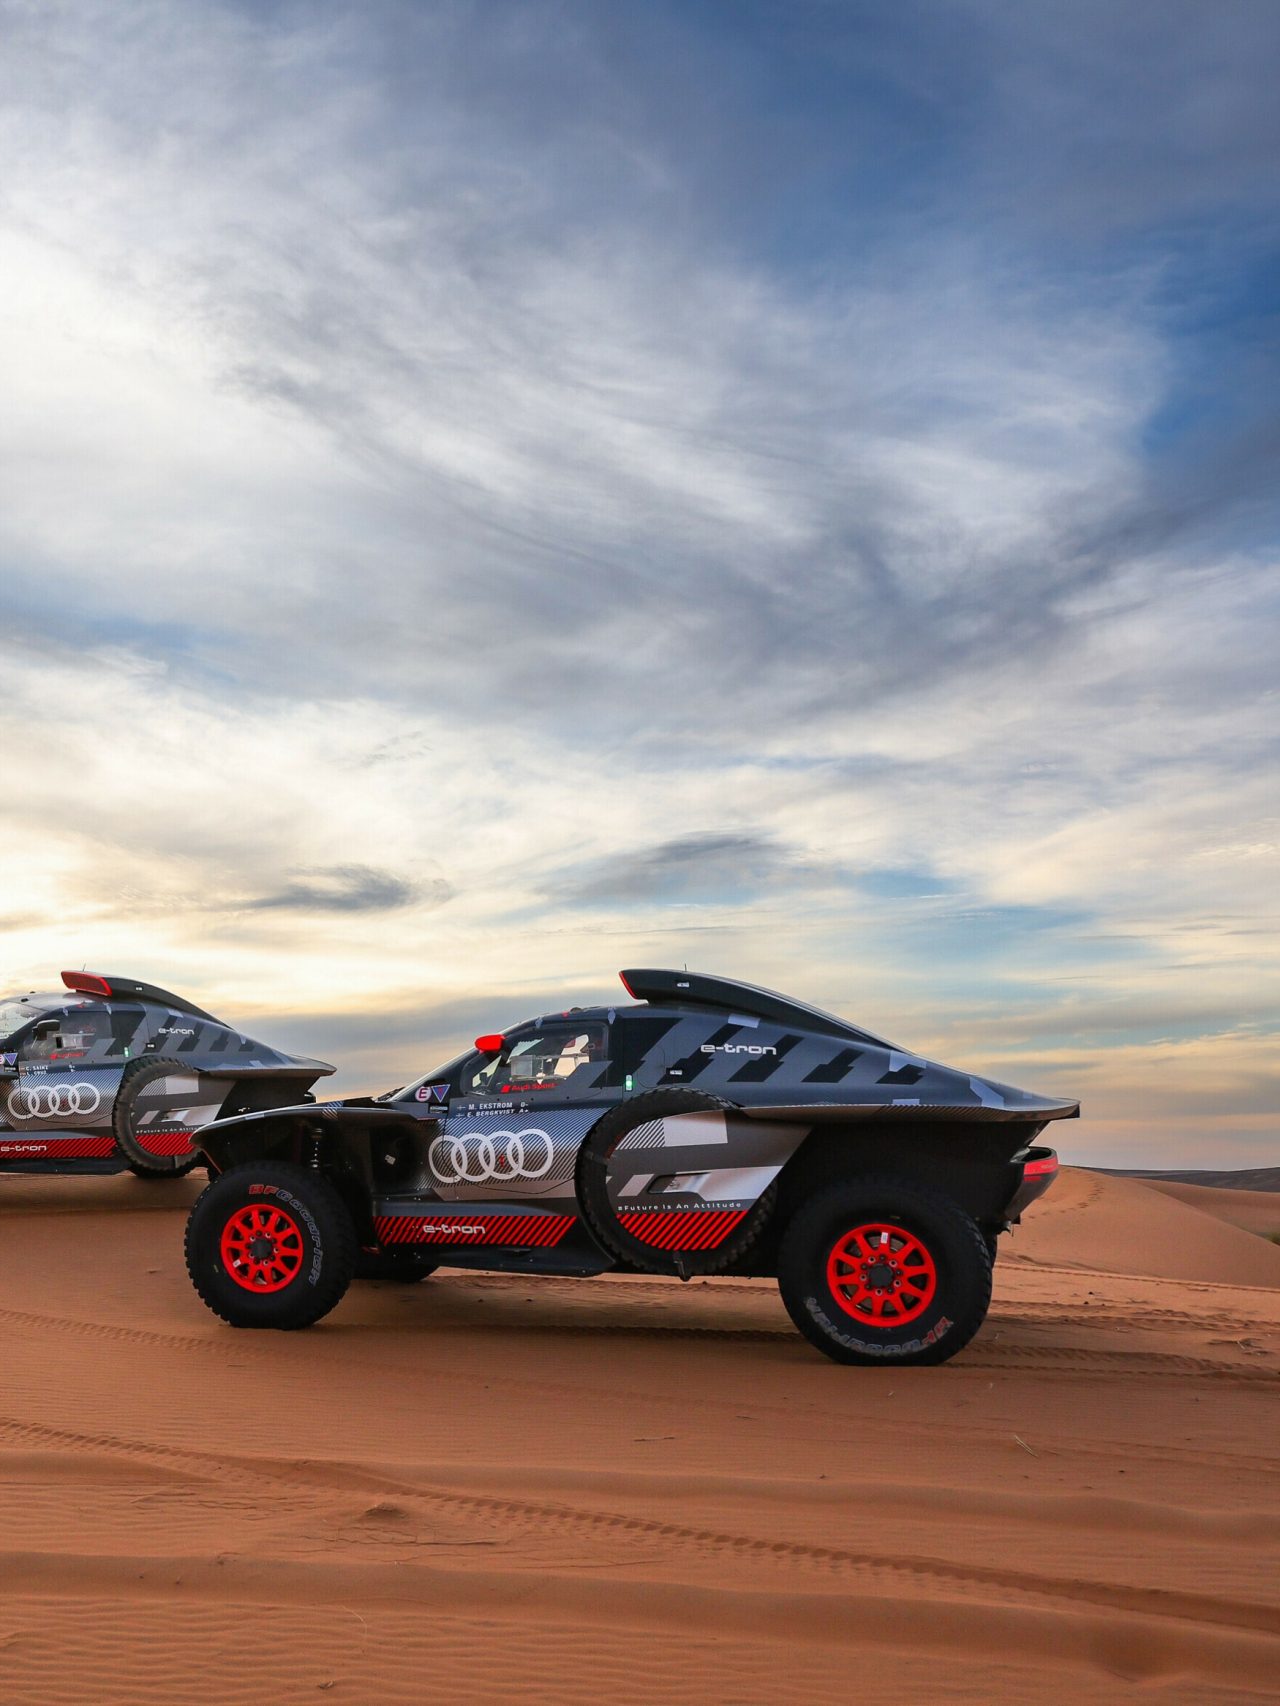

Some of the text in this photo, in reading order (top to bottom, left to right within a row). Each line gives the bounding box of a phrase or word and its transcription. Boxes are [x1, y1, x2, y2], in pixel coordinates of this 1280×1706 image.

[158, 1027, 195, 1035] e-tron
[700, 1043, 777, 1055] e-tron
[418, 1087, 428, 1099] E
[475, 1108, 515, 1116] BERGKVIST
[423, 1224, 486, 1234] e-tron
